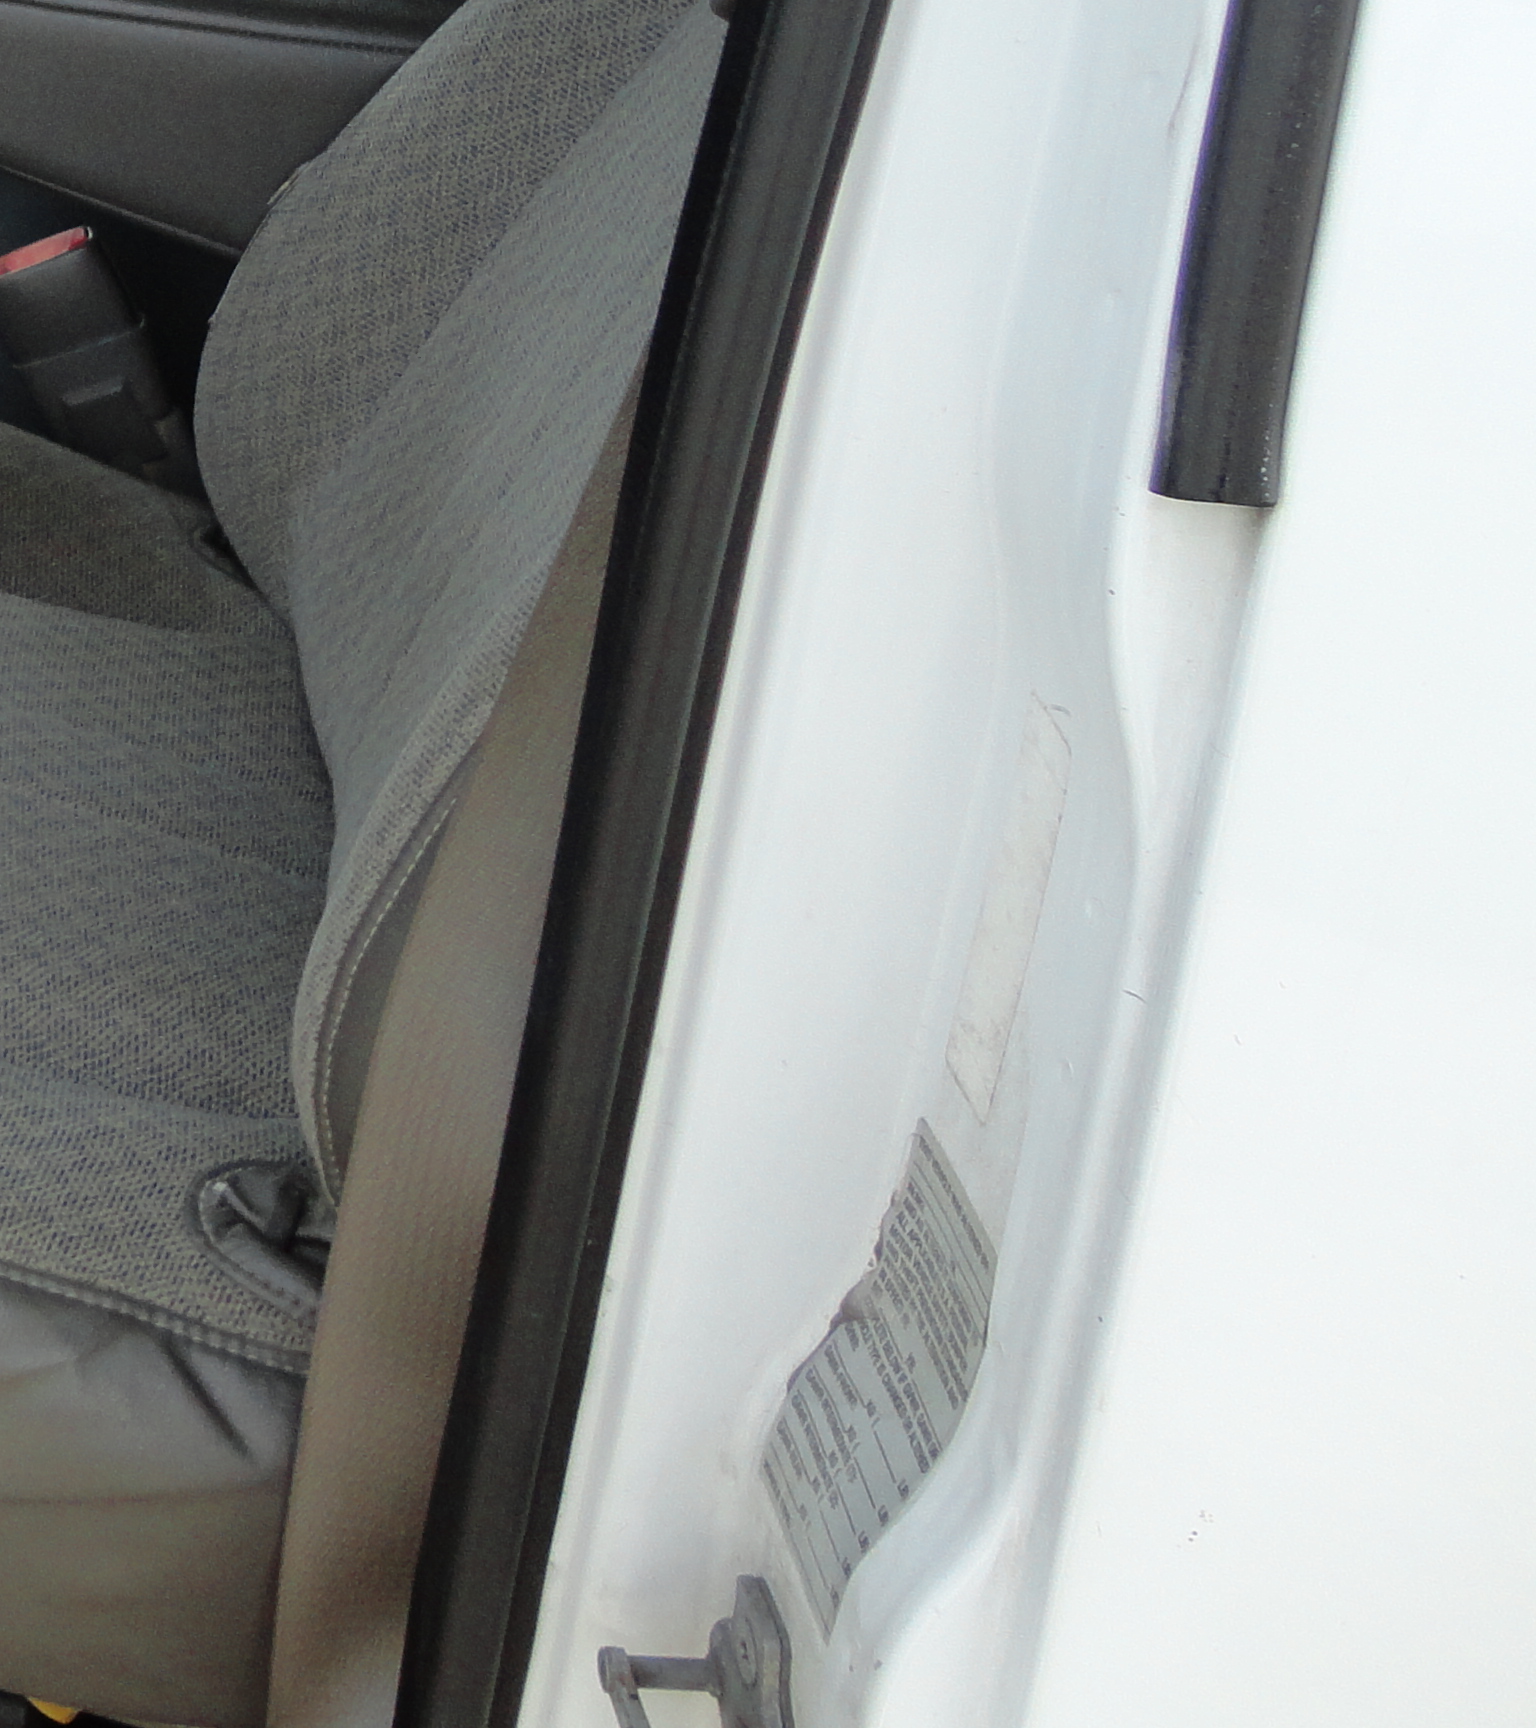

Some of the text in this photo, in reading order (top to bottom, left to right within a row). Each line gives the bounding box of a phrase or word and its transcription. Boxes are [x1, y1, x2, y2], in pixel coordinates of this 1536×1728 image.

[888, 1222, 914, 1262] MOTOR
[882, 1337, 902, 1377] BELOW
[867, 1338, 881, 1368] TYPE
[880, 1370, 907, 1421] CHANGED
[908, 1428, 930, 1477] ALTERED
